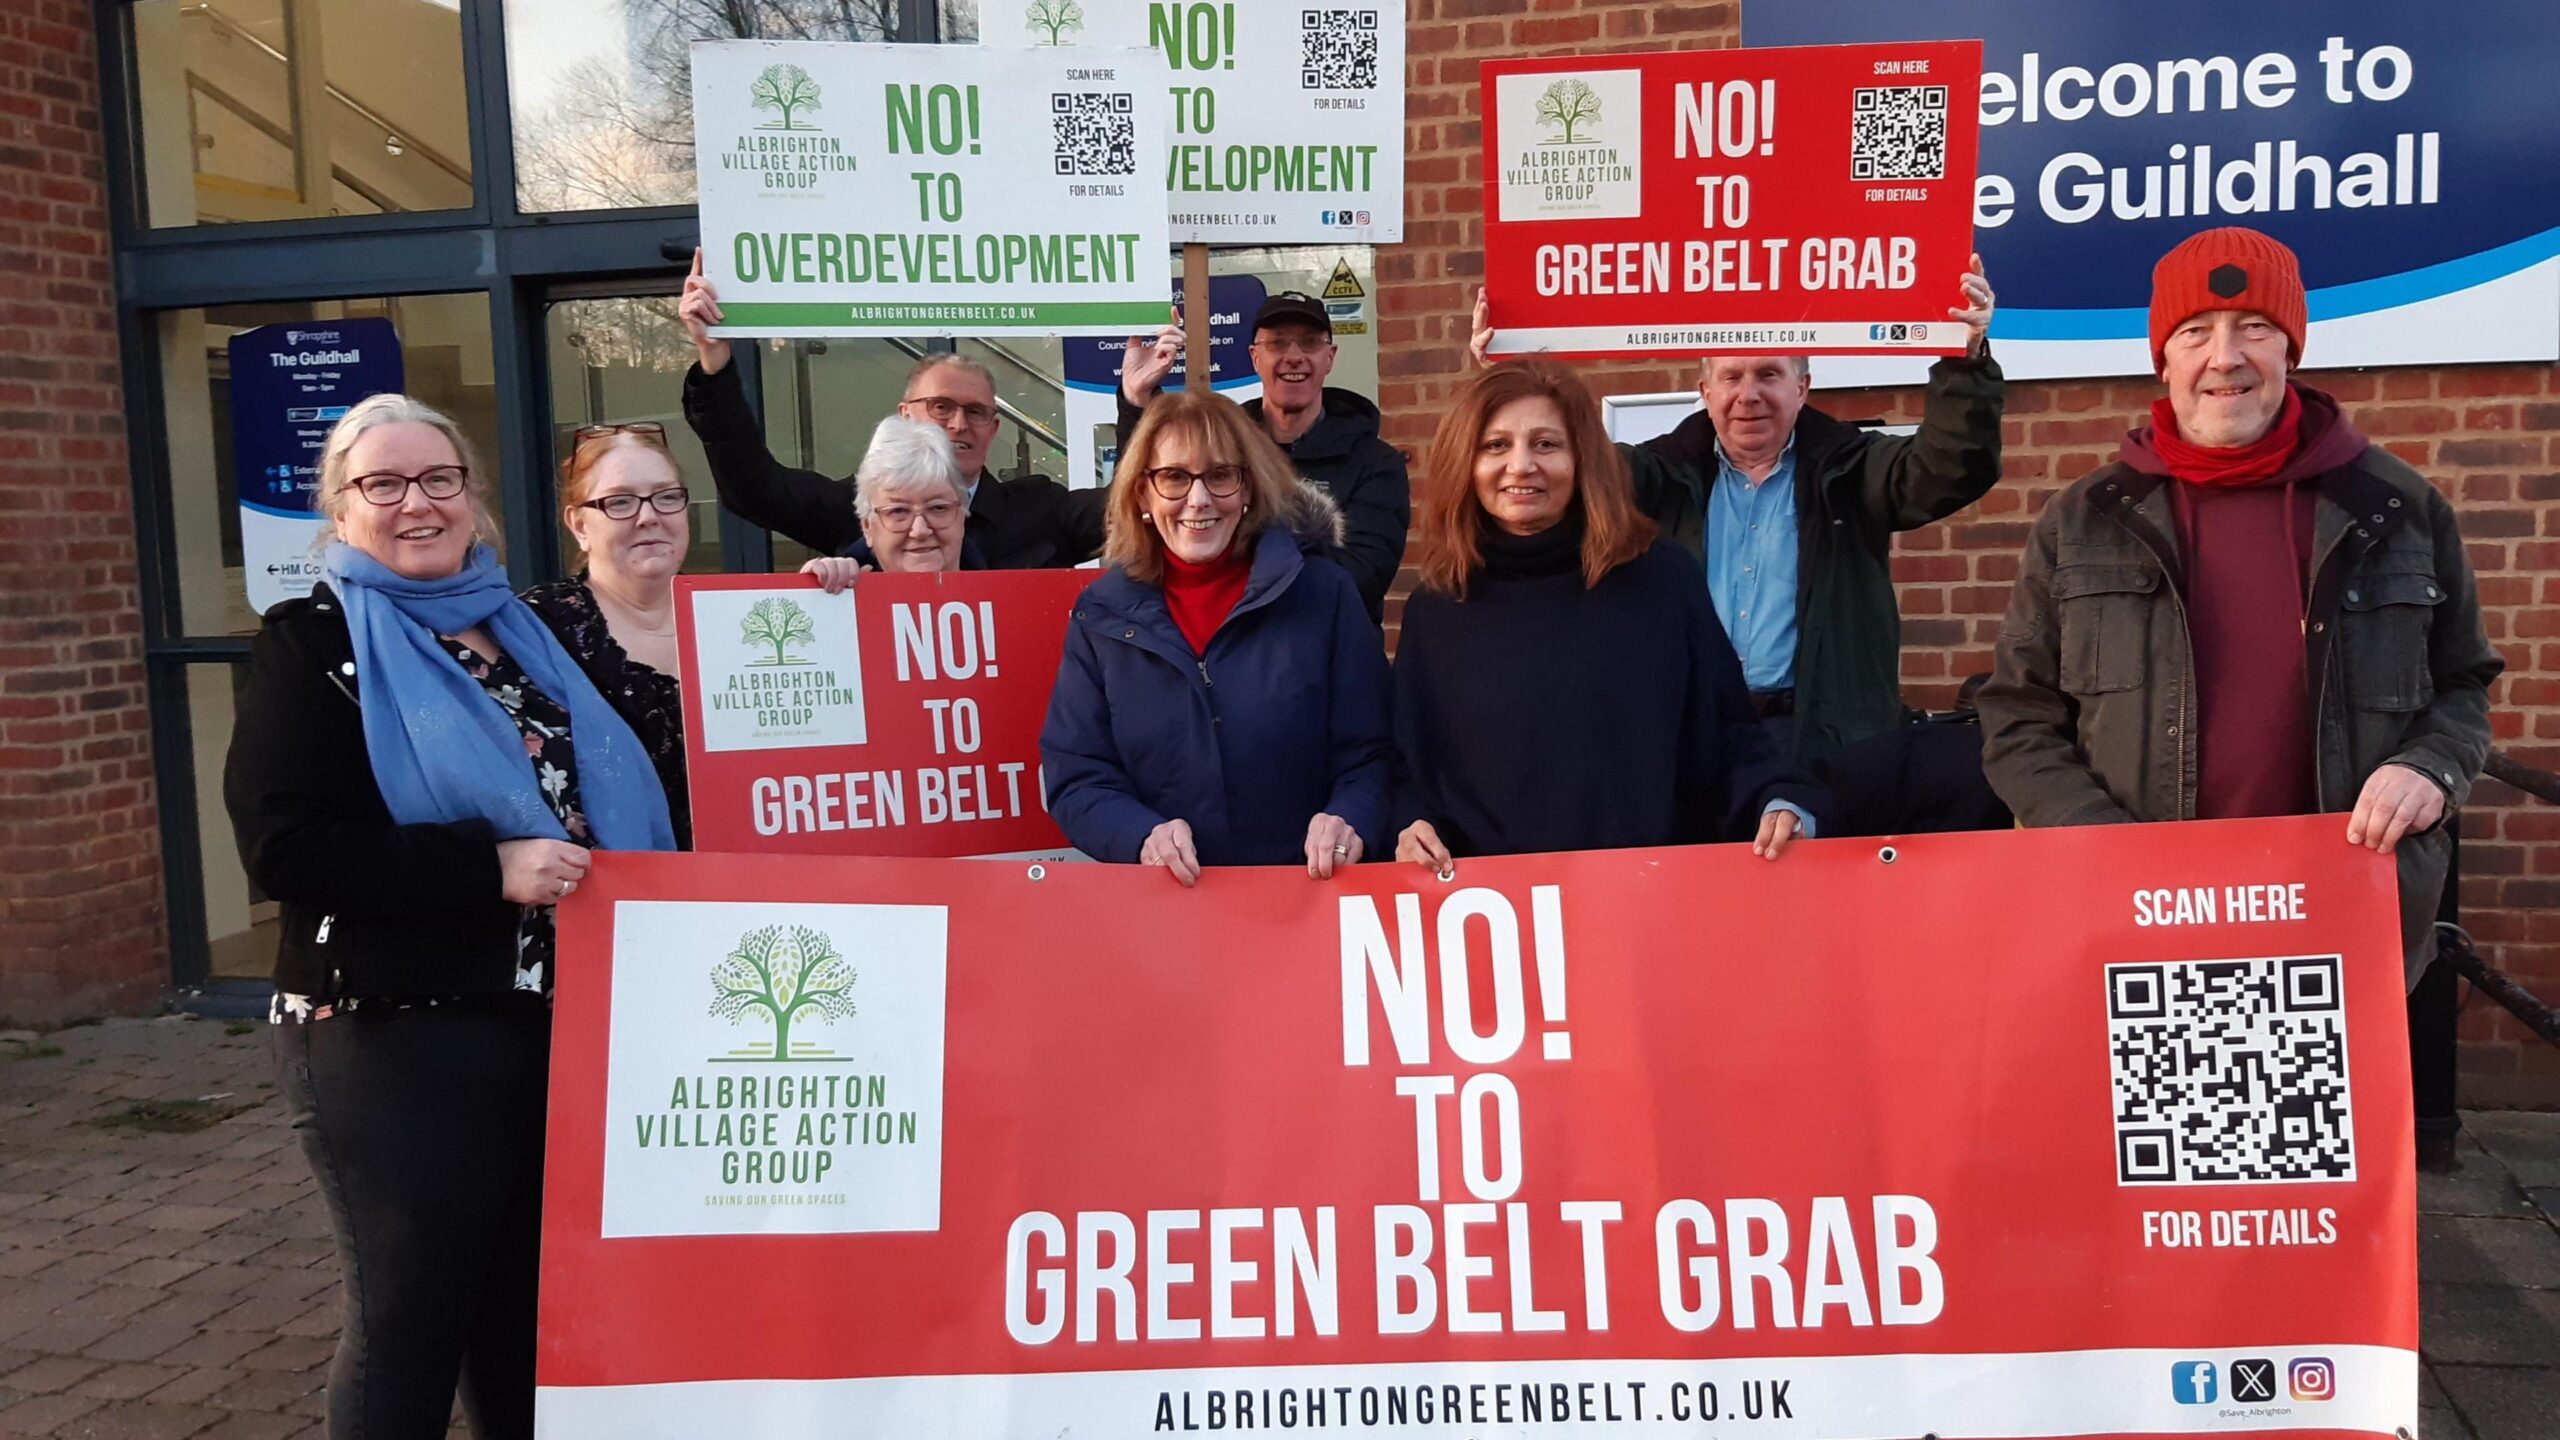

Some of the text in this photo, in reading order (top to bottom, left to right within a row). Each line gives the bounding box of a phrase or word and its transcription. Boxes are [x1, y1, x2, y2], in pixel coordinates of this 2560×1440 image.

[1149, 2, 1235, 71] NO!
[1066, 69, 1116, 81] SCAN HERE
[1873, 60, 1930, 75] SCAN HERE
[1980, 36, 2413, 126] elcome to
[1170, 87, 1215, 135] TO
[1314, 99, 1364, 110] FOR DETAILS
[885, 84, 982, 156] NO!
[1674, 79, 1775, 159] NO!
[737, 136, 840, 154] ALBRIGHTON
[1521, 149, 1617, 167] ALBRIGHTON
[722, 154, 857, 172] VILLAGE ACTION
[1166, 145, 1378, 192] VELOPMENT
[1506, 165, 1633, 186] VILLAGE ACTION
[764, 172, 818, 190] GROUP
[1069, 184, 1124, 197] FOR DETAILS
[2039, 132, 2440, 224] Guildhall
[911, 172, 963, 223] TO
[1545, 185, 1594, 201] GROUP
[1697, 176, 1749, 229] TO
[1865, 188, 1928, 202] FOR DETAILS
[1168, 214, 1277, 225] NGREENBELT.CO.UK
[733, 232, 1140, 284] OVERDEVELOPMENT
[1535, 237, 1916, 296] GREEN BELT GRAB
[851, 306, 1036, 320] ALBRIGHTONGREENBELT.CO.UK
[1210, 313, 1240, 325] dhall
[1098, 341, 1127, 350] Counc
[1627, 328, 1817, 345] ALBRIGHTONGREENBELT.CO.UK
[270, 349, 360, 367] The Guildhall
[281, 564, 299, 575] HM
[892, 601, 998, 681] NO!
[728, 671, 835, 690] ALBRIGHTON
[713, 689, 854, 710] VILLAGE ACTION
[758, 709, 813, 727] GROUP
[923, 697, 981, 754] TO
[752, 770, 906, 836] GREEN
[918, 762, 1024, 824] BELT
[2133, 884, 2306, 927] SCAN HERE
[1339, 884, 1571, 1066] NO!
[670, 1075, 886, 1109] ALBRIGHTON
[636, 1112, 917, 1147] VILLAGE ACTION
[1395, 1073, 1523, 1201] TO
[722, 1150, 832, 1184] GROUP
[705, 1194, 846, 1206] SAVING OUR GREEN SPACES
[2143, 1208, 2337, 1247] FOR DETAILS
[1004, 1194, 1944, 1347] GREEN BELT GRAB
[1154, 1380, 1794, 1433] ALBRIGHTONGREENBELT.CO.UK
[2219, 1408, 2291, 1418] @Save_Albrighton
